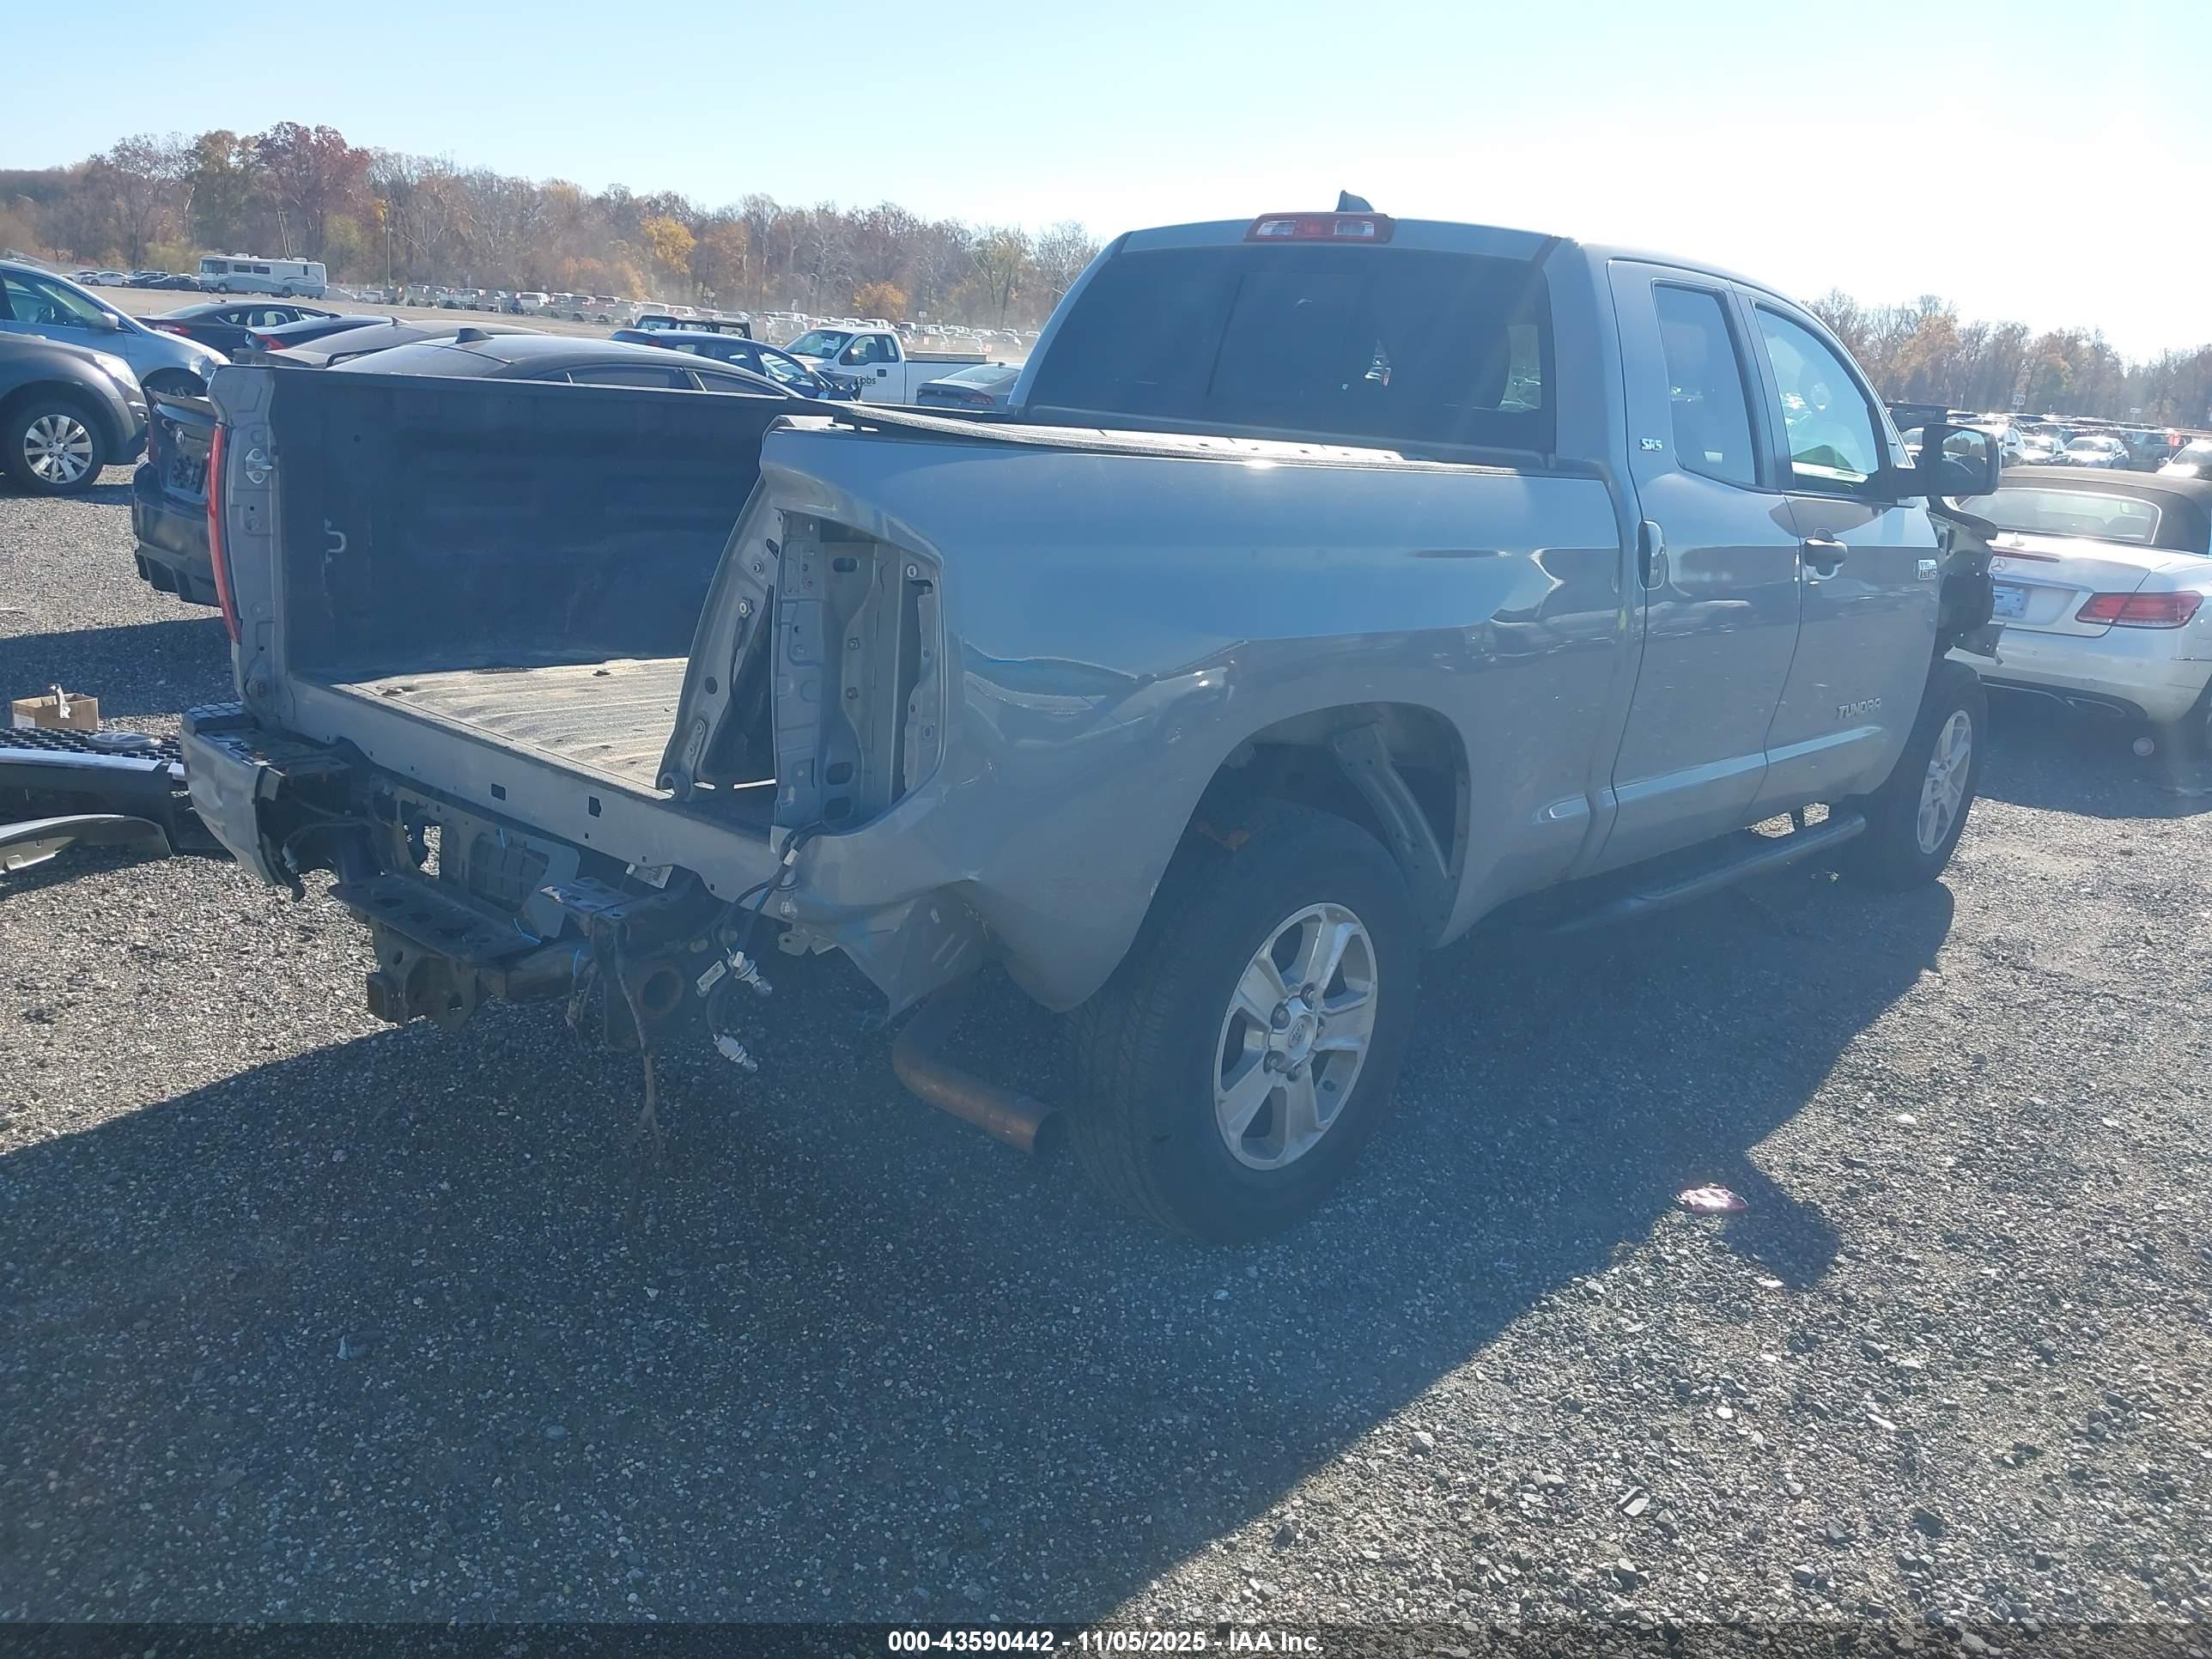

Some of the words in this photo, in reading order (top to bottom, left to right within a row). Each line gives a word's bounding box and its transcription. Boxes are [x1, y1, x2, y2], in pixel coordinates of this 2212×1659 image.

[2014, 395, 2025, 404] 70
[1641, 438, 1663, 452] SR5
[1836, 698, 1881, 719] TUNDRA
